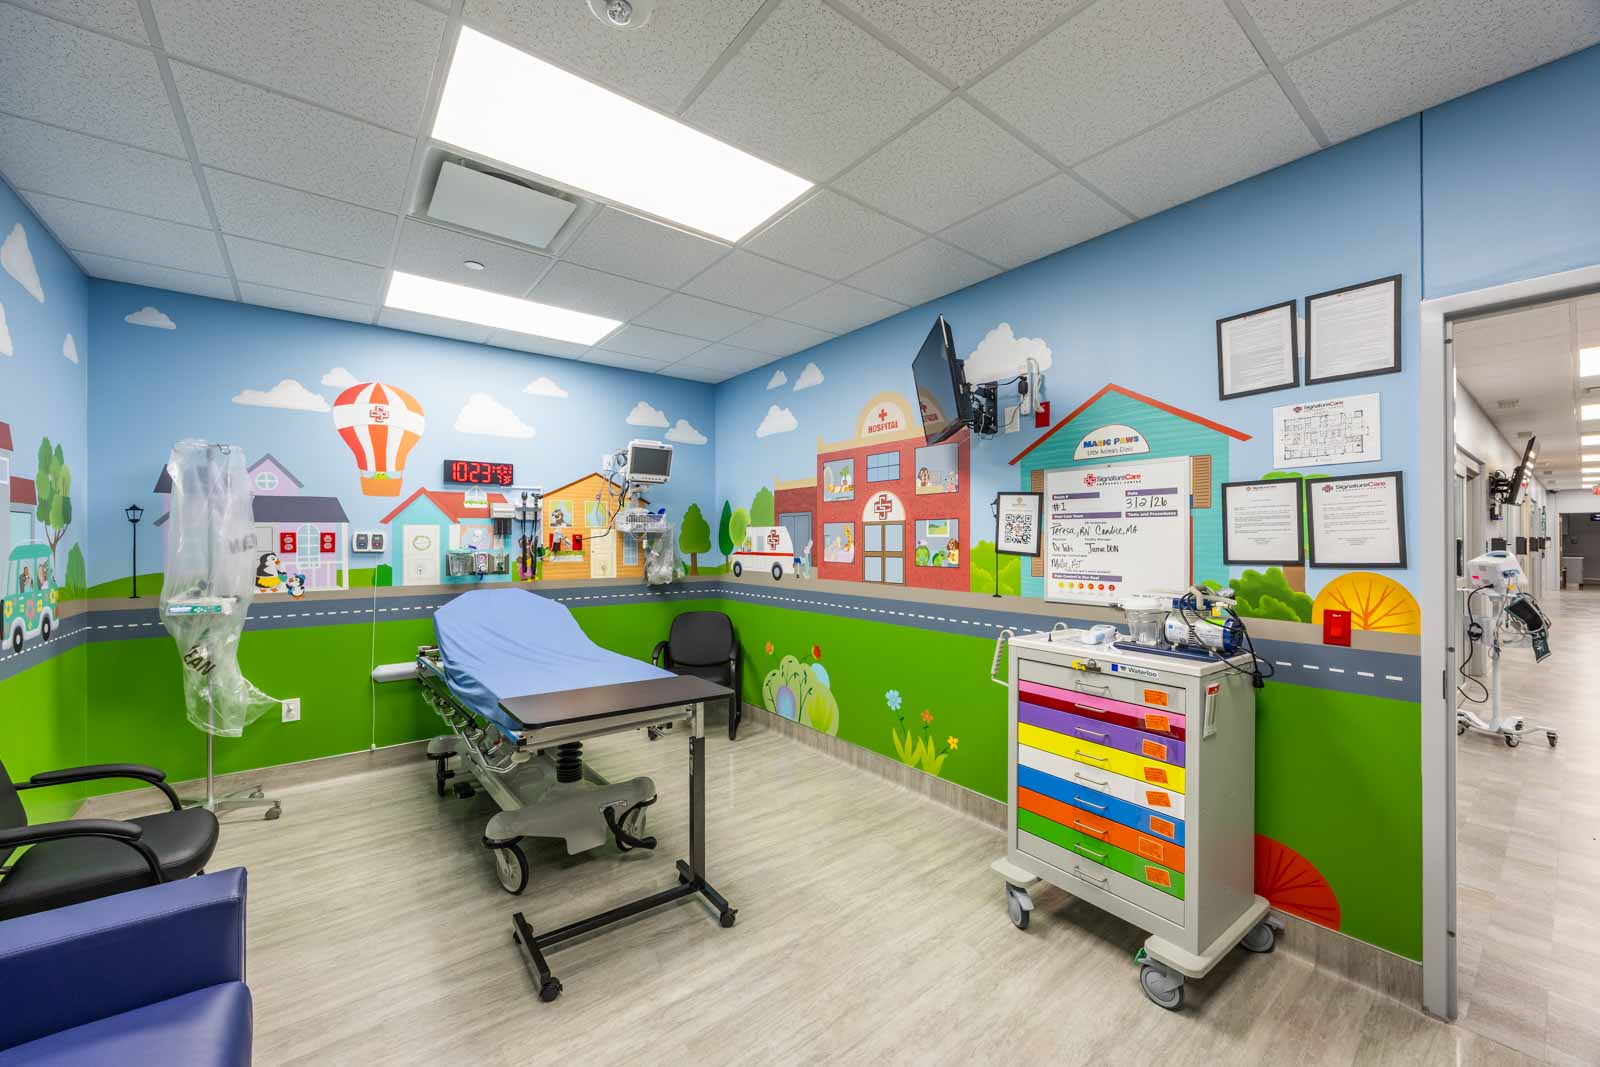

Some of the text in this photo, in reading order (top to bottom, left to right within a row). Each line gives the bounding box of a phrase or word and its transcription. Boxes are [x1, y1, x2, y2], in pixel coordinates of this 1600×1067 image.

[868, 420, 898, 433] HOSPITAL
[1096, 473, 1142, 483] SignatureCare
[1128, 667, 1158, 678] Waterloo
